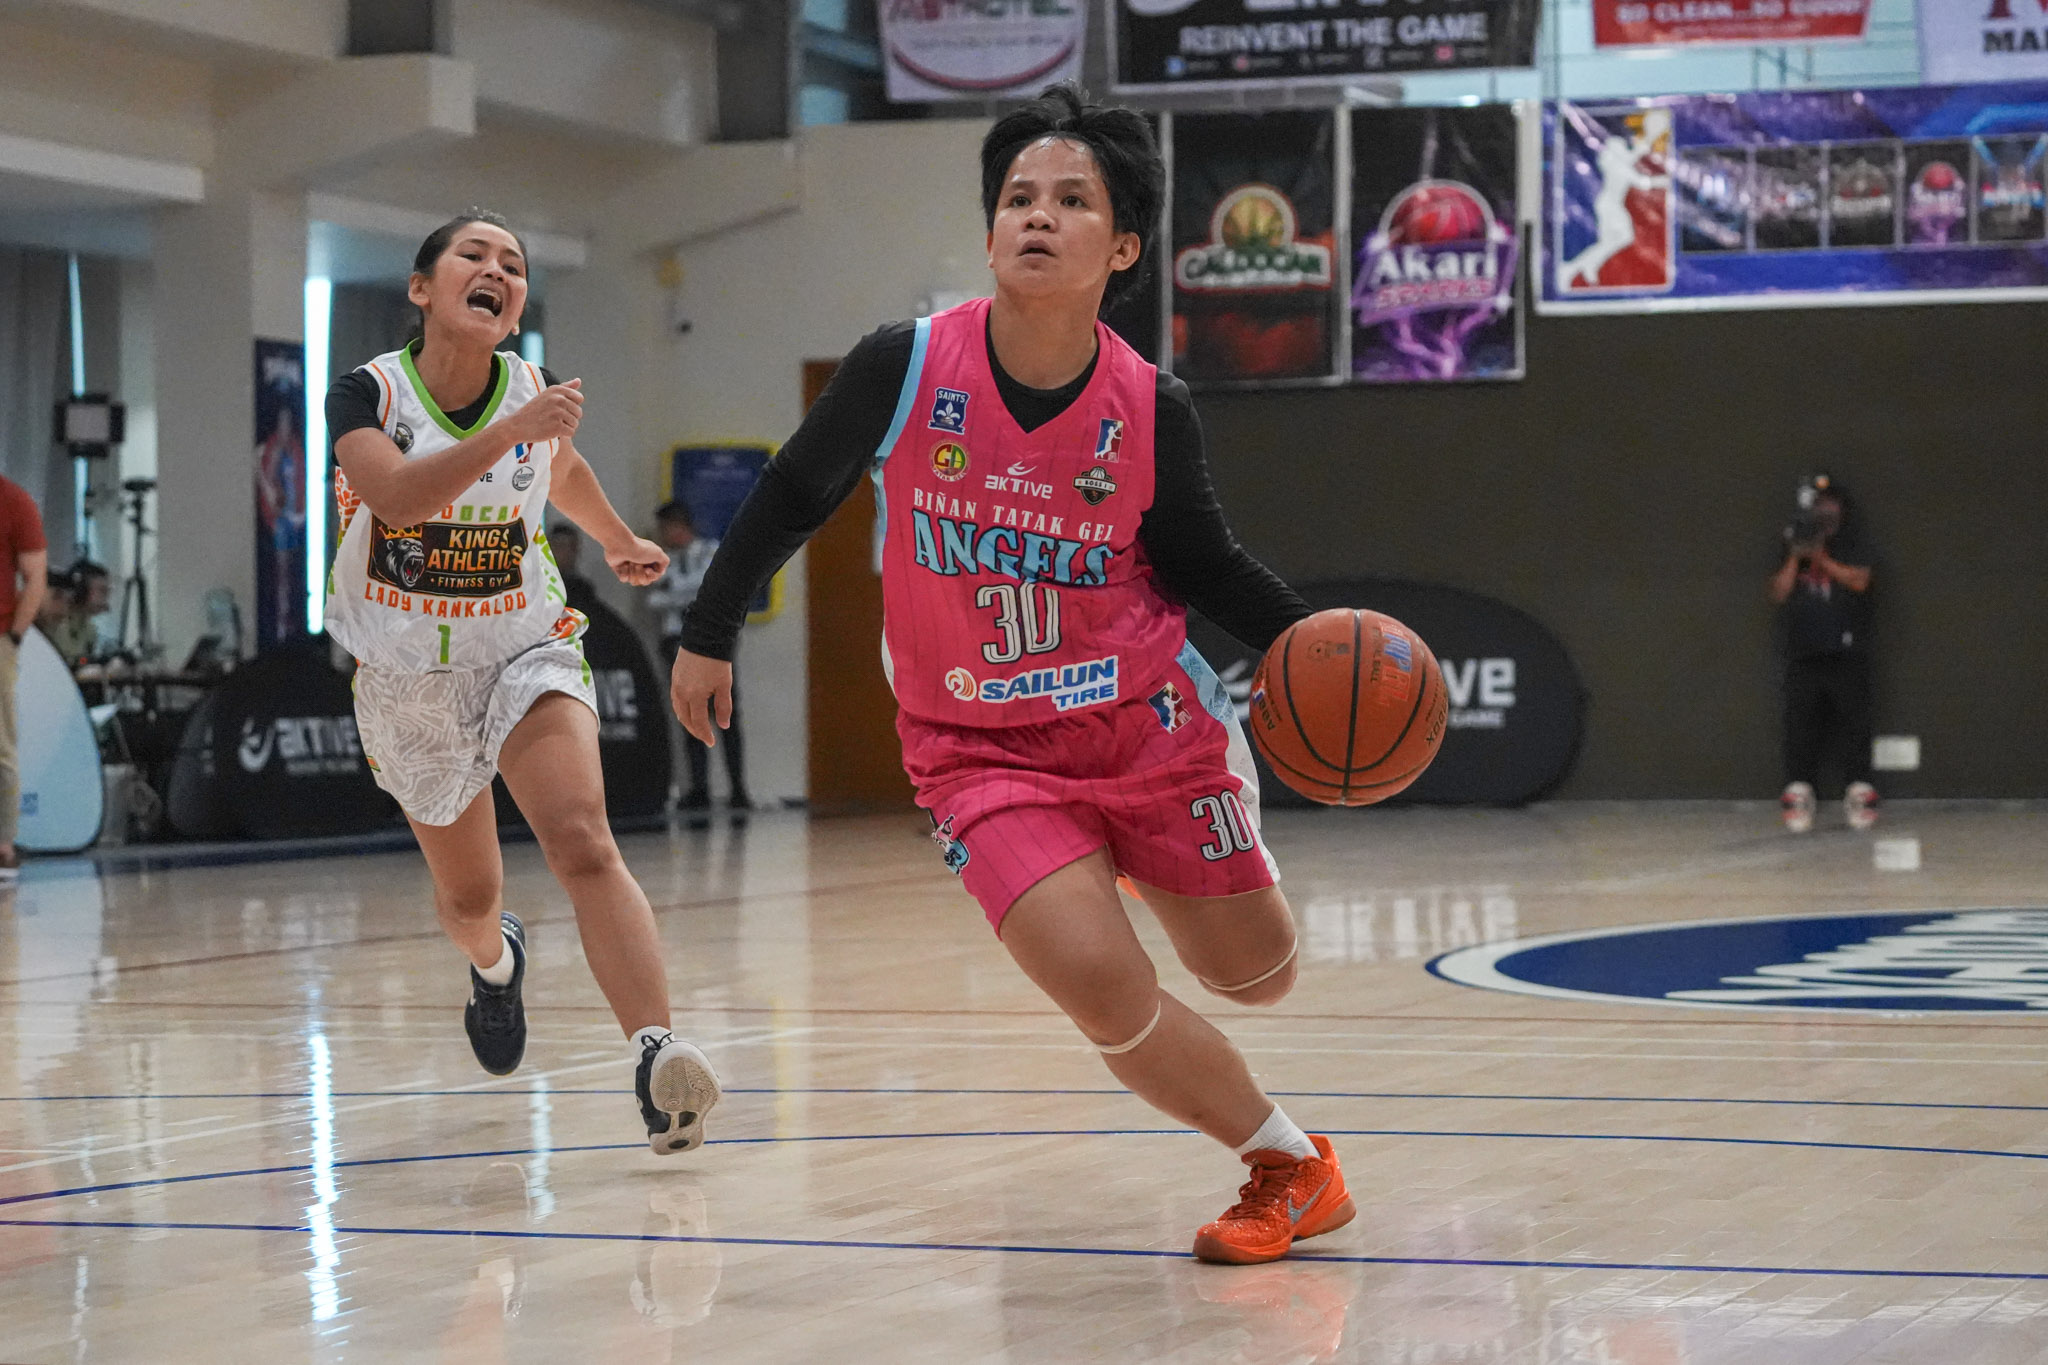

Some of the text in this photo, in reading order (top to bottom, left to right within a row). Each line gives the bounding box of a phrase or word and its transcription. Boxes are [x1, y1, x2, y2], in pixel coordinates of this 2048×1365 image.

[1180, 12, 1489, 53] REINVENT THE GAME
[1372, 245, 1499, 285] Akari
[937, 390, 966, 403] SAINTS
[914, 487, 978, 520] BIÑAN
[992, 505, 1065, 535] TATAK
[427, 545, 524, 571] ATHLETICS
[448, 528, 510, 550] KINGS
[364, 582, 412, 612] LADY
[437, 576, 484, 588] FITNESS
[975, 582, 1061, 665] 30
[437, 623, 450, 665] 1
[982, 657, 1115, 700] SAILUN
[1056, 683, 1115, 708] TIRE
[1190, 789, 1255, 862] 30
